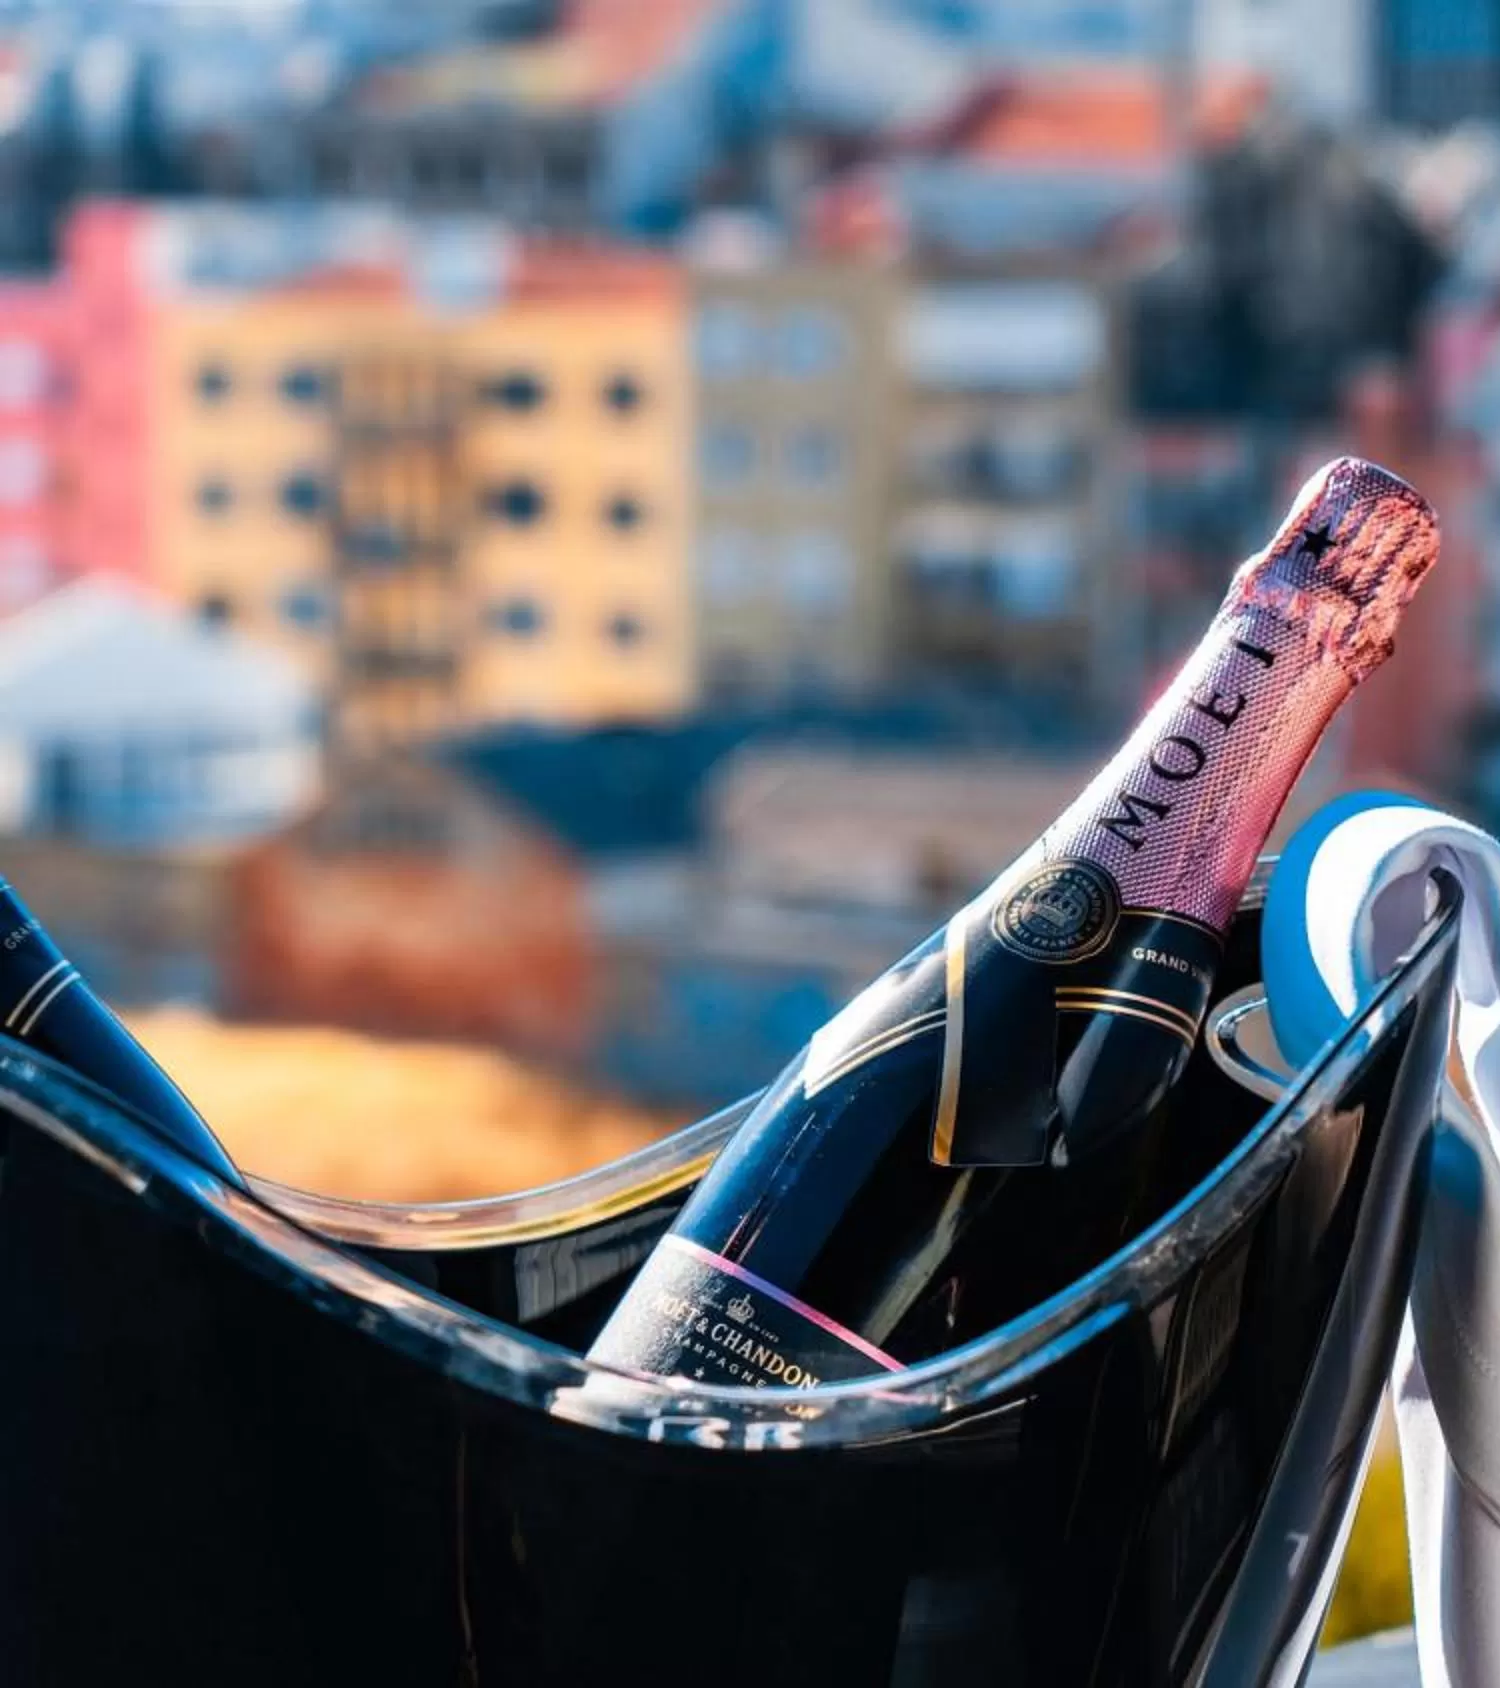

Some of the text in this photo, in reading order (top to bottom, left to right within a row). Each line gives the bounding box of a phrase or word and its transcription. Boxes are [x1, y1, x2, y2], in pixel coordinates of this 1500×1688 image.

[1131, 947, 1189, 973] GRAND
[663, 1327, 767, 1389] CHAMPAGNE
[695, 1317, 709, 1335] &
[711, 1323, 820, 1391] CHANDON
